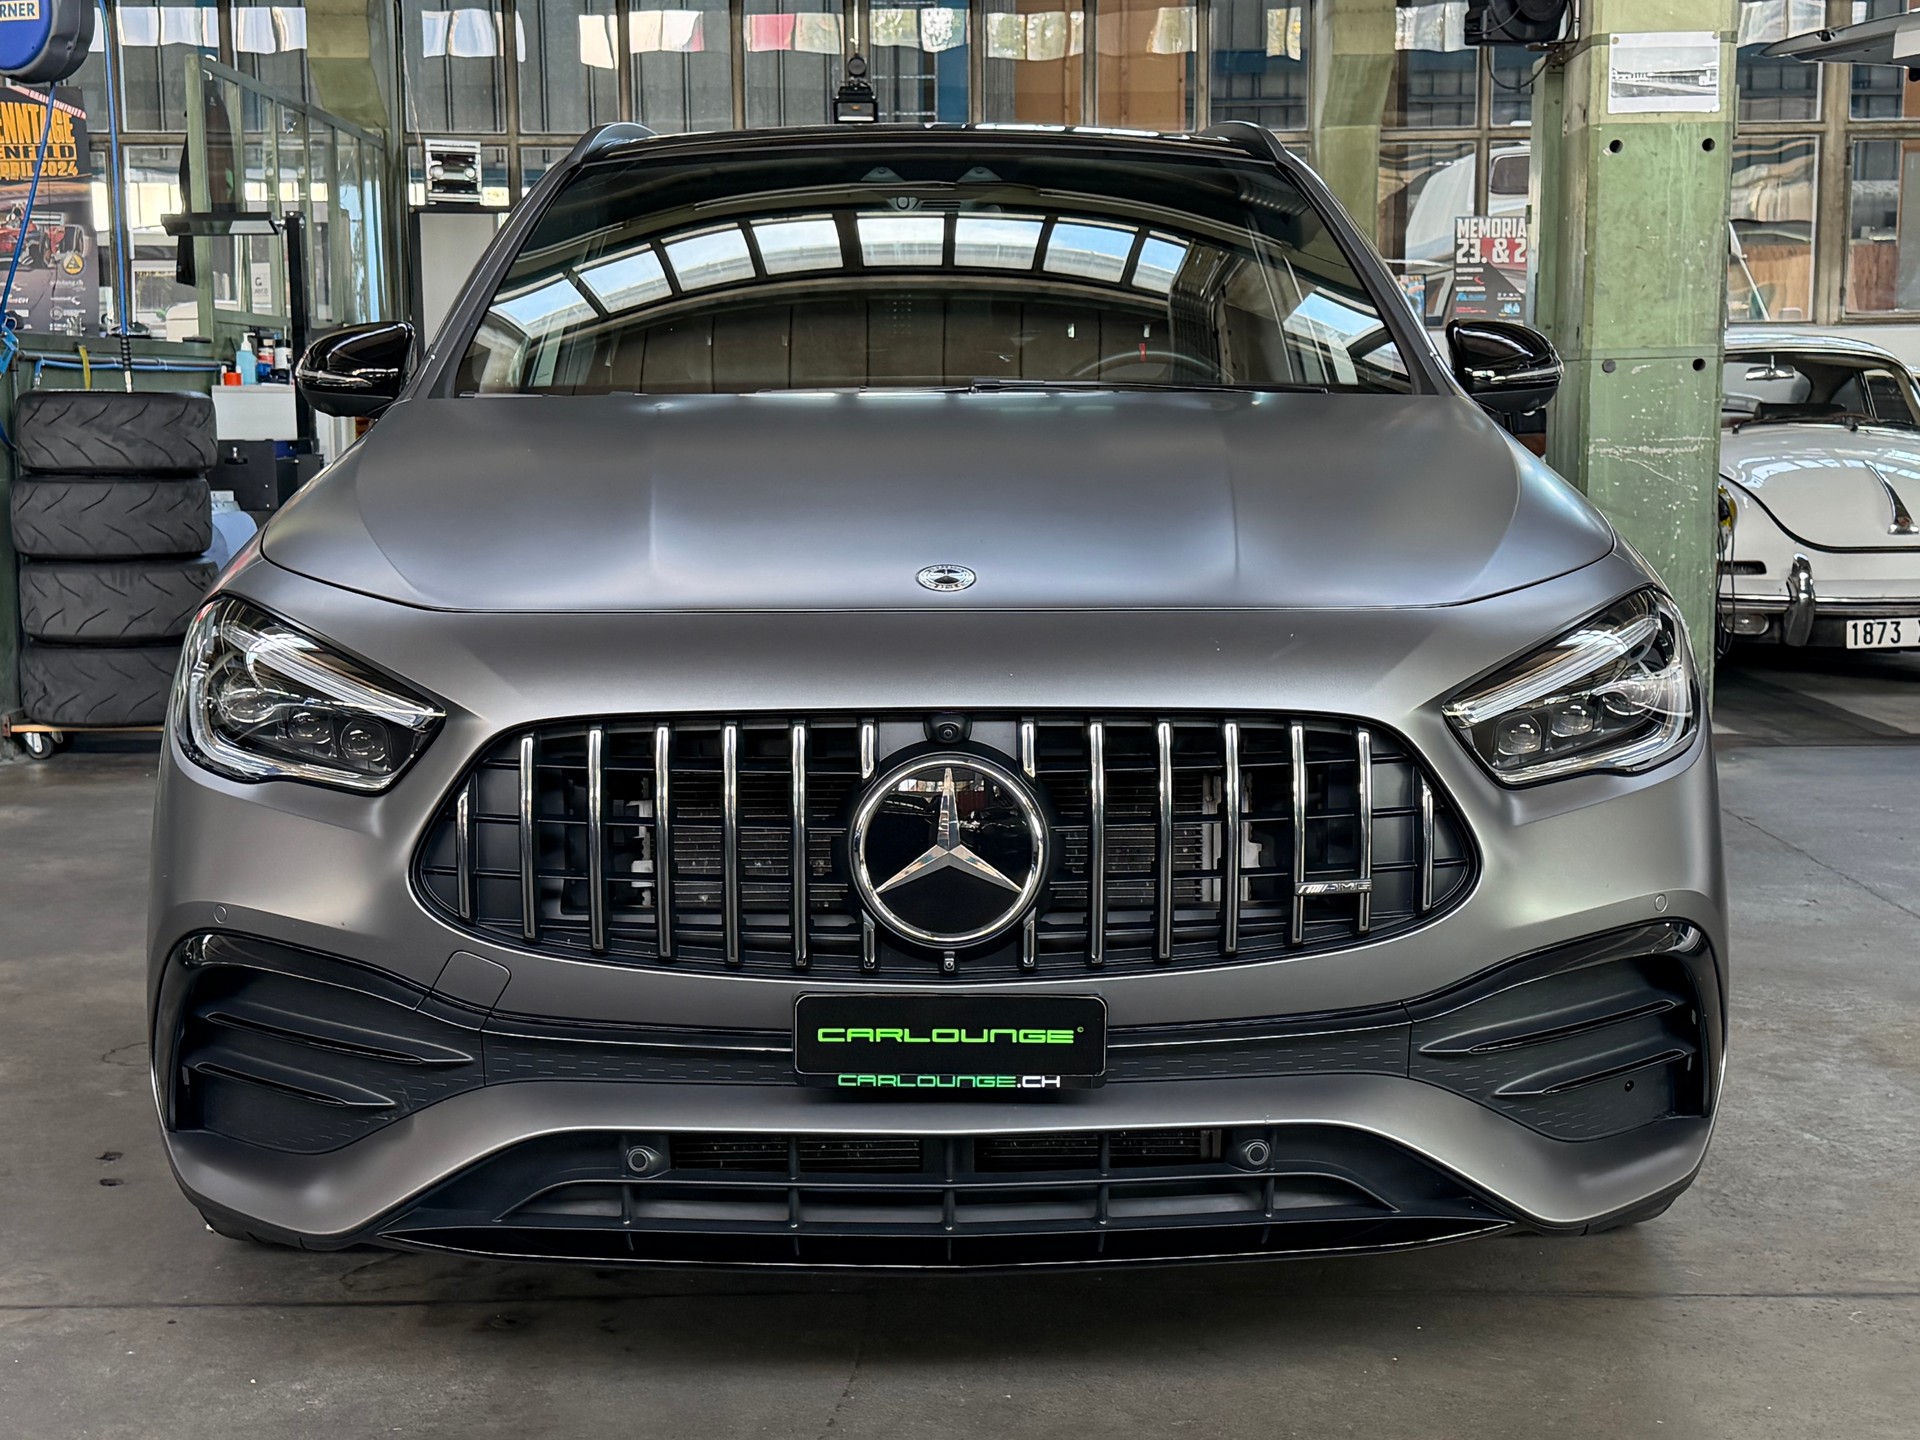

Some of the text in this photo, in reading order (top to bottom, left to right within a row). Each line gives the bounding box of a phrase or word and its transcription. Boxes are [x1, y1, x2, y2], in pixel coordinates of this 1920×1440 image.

[40, 160, 79, 177] 2024
[1456, 217, 1527, 239] MEMORIA
[1456, 238, 1488, 264] 23.
[1492, 238, 1510, 264] &
[1852, 620, 1902, 646] 1873
[817, 1027, 1075, 1044] CARLOUNGE
[837, 1074, 1061, 1089] CARLOUNGE.CH
